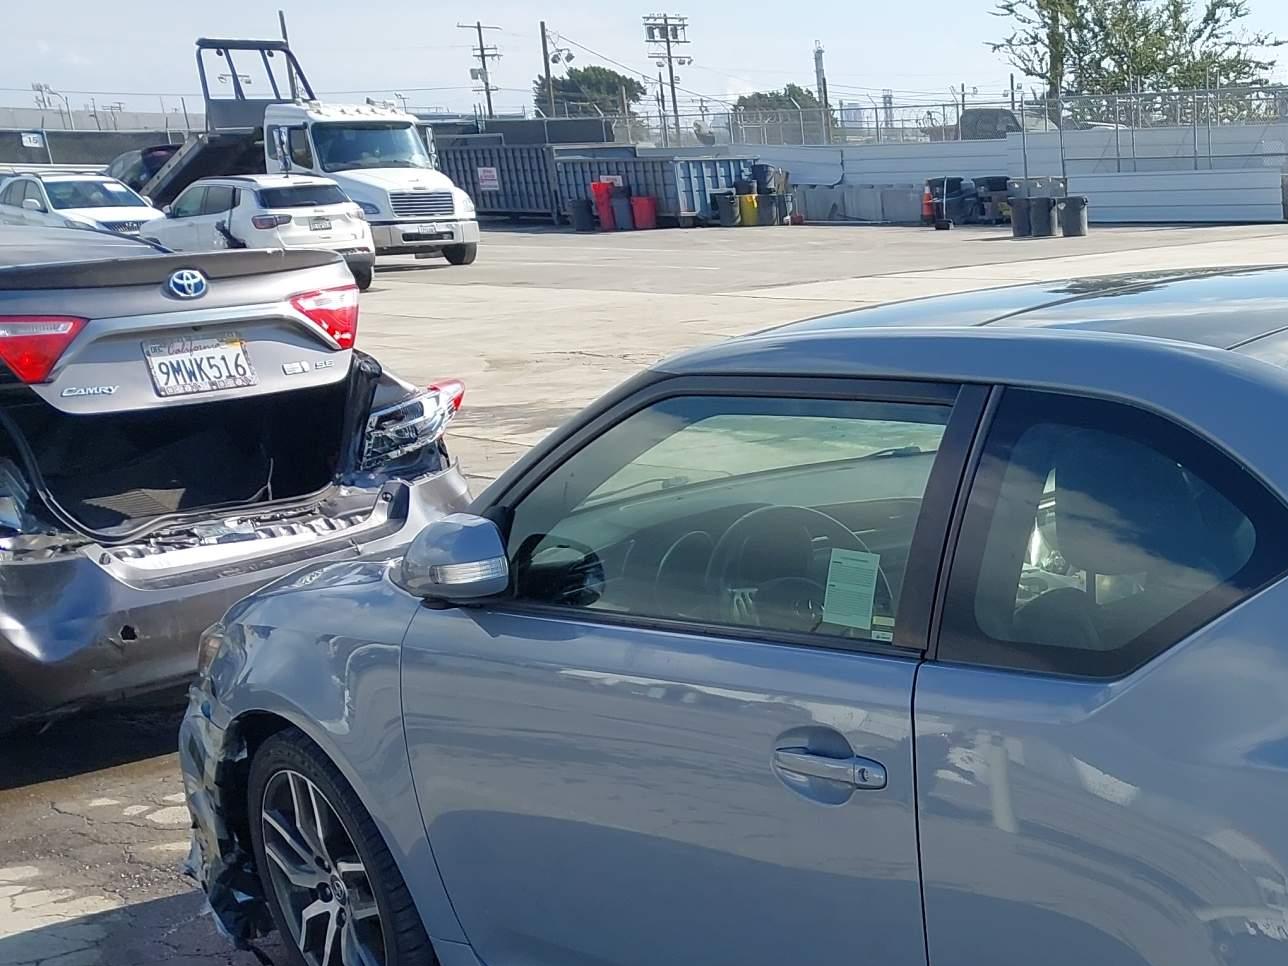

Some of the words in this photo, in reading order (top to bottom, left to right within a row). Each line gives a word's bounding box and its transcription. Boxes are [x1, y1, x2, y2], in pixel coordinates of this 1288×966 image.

[167, 340, 220, 356] California
[158, 353, 247, 385] 9MWK516
[60, 385, 121, 398] CAMRY
